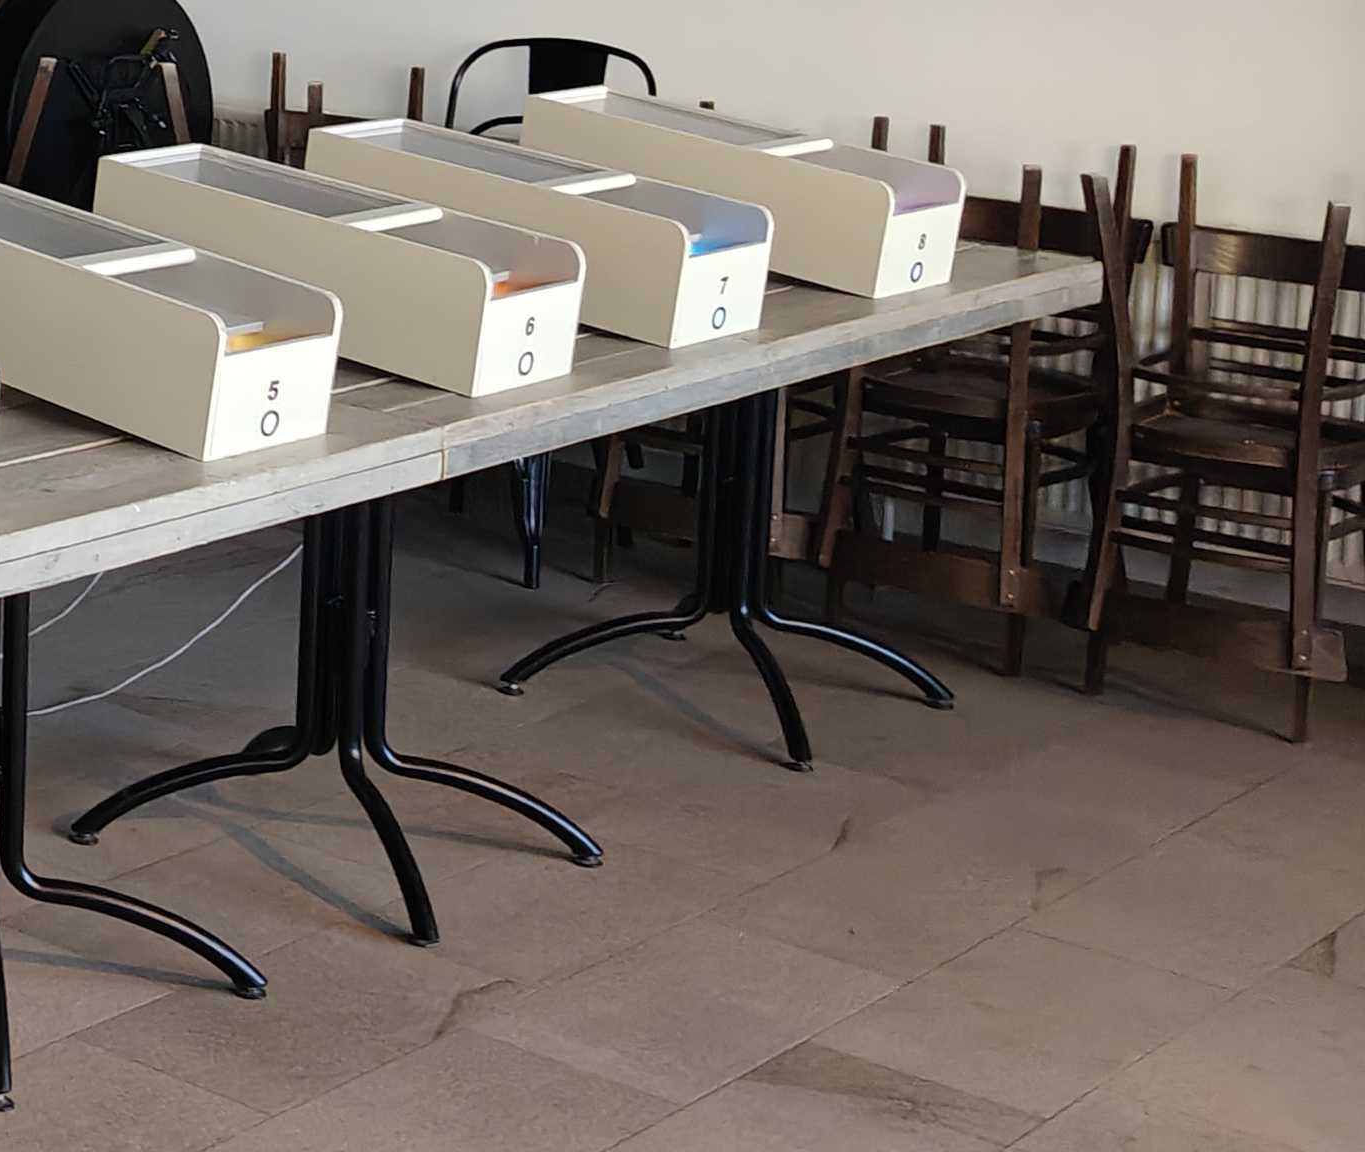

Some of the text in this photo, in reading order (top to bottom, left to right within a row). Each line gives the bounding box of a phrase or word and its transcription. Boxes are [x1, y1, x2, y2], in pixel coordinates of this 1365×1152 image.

[917, 233, 927, 250] 8
[720, 276, 729, 295] 7
[525, 316, 536, 337] 6
[267, 380, 280, 401] 5
